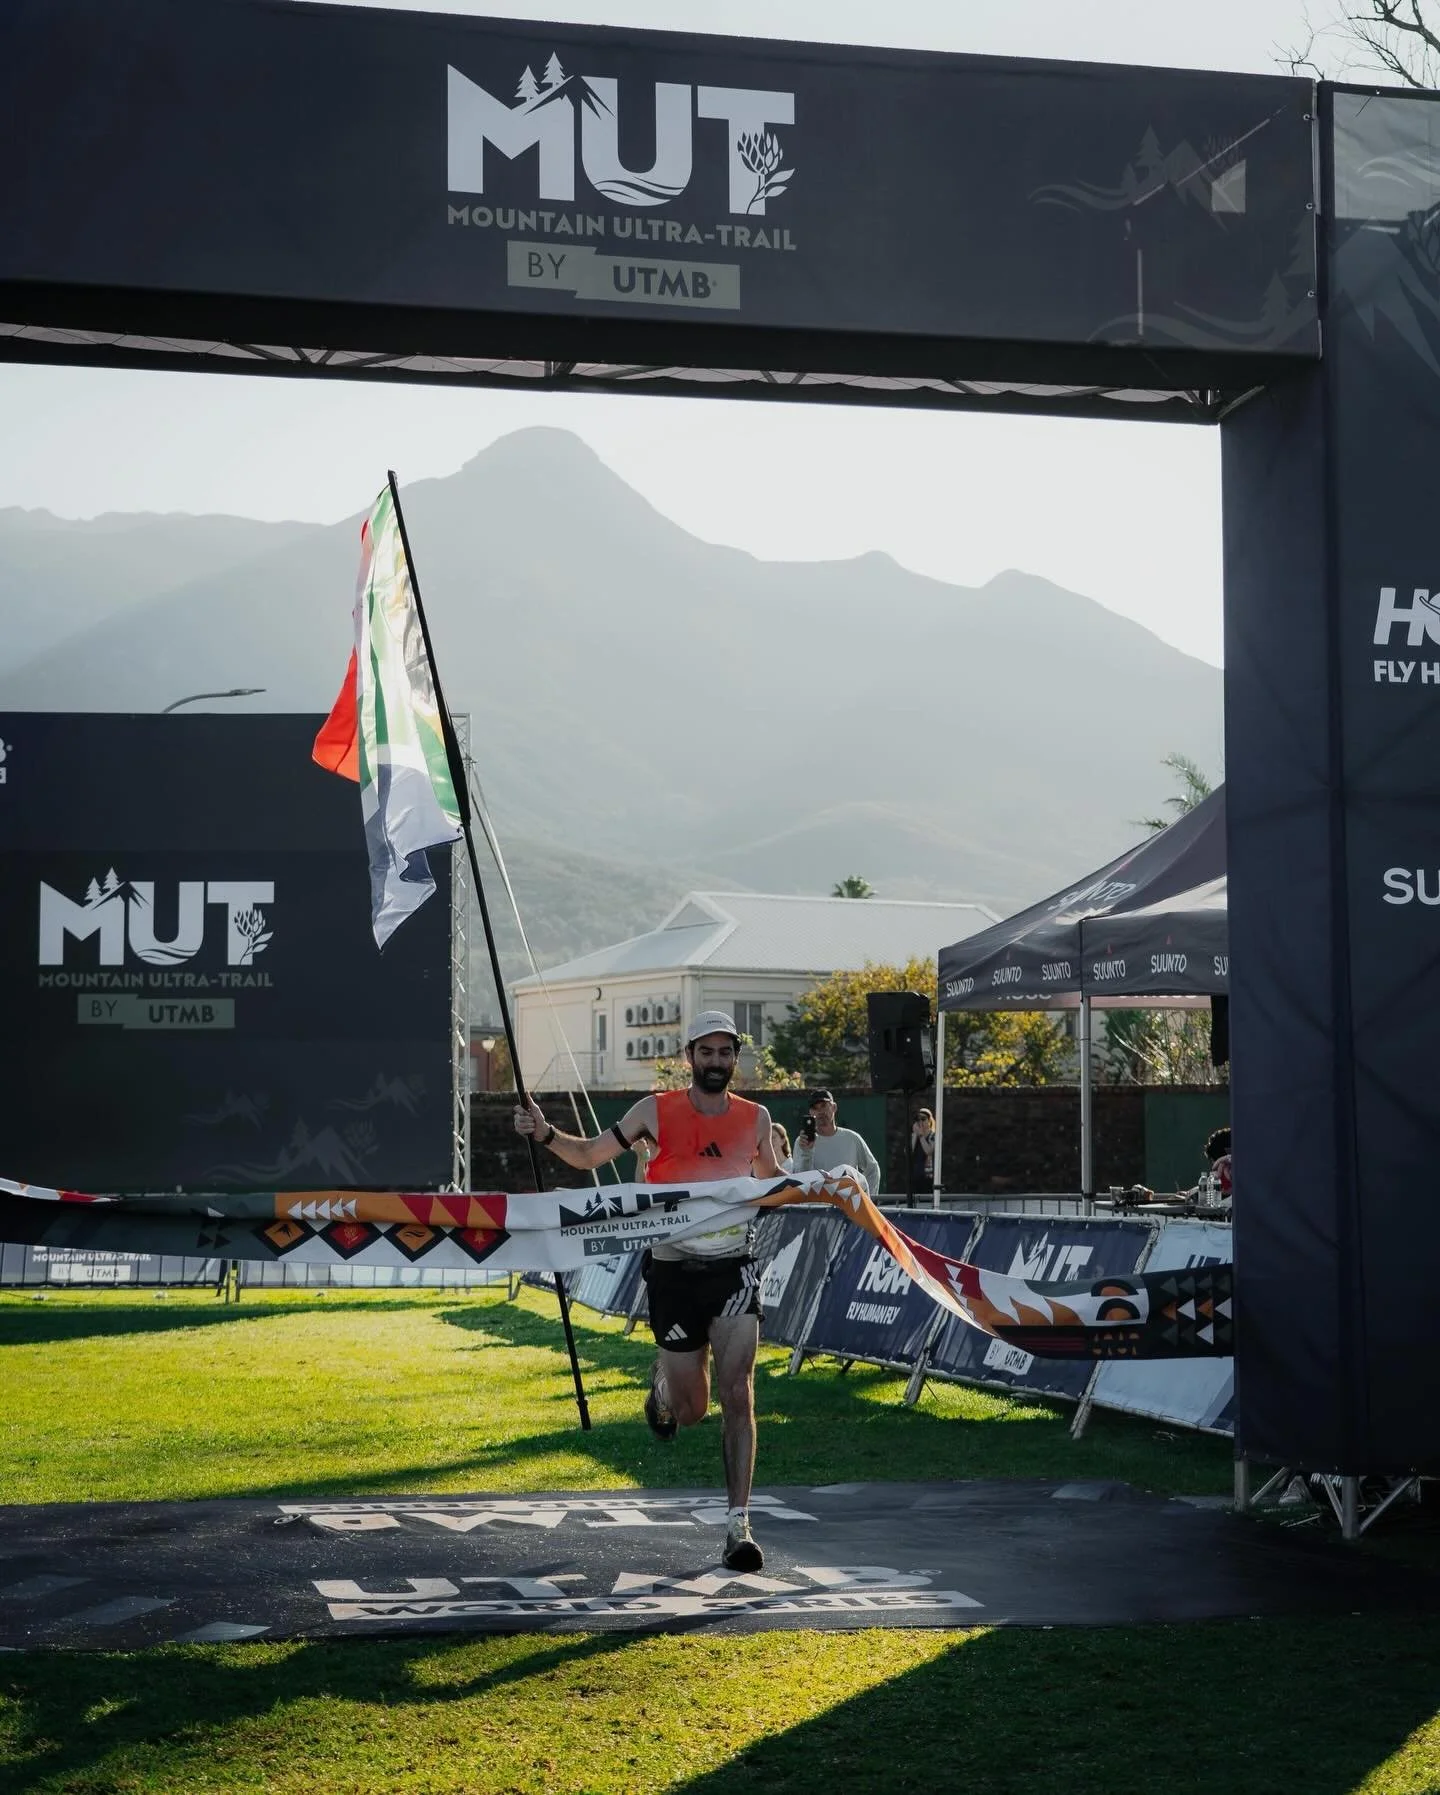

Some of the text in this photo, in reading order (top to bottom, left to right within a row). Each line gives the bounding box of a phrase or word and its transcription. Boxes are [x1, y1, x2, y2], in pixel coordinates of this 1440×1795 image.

[447, 63, 796, 216] MUT
[447, 204, 797, 251] MOUNTAIN ULTRA-TRAIL
[527, 251, 712, 299] BY UTMB
[1373, 660, 1416, 683] FLY
[39, 880, 275, 965] MUT
[1041, 961, 1072, 981] SUUNTO
[1093, 959, 1126, 981] SUUNTO
[1151, 954, 1187, 973] SUUNTO
[39, 973, 274, 988] MOUNTAIN ULTRA-TRAIL
[946, 977, 975, 997] SUUNTO
[991, 966, 1022, 986] SUUNTO
[91, 999, 216, 1023] BY UTMB
[560, 1214, 691, 1237] MOUNTAIN ULTRA-TRAIL
[591, 1240, 606, 1252] BY
[846, 1302, 901, 1325] FLY HUMAN FLY
[1005, 1350, 1028, 1370] UTMB
[312, 1566, 934, 1600] UTMB
[357, 1593, 953, 1616] WORLD SERIES
